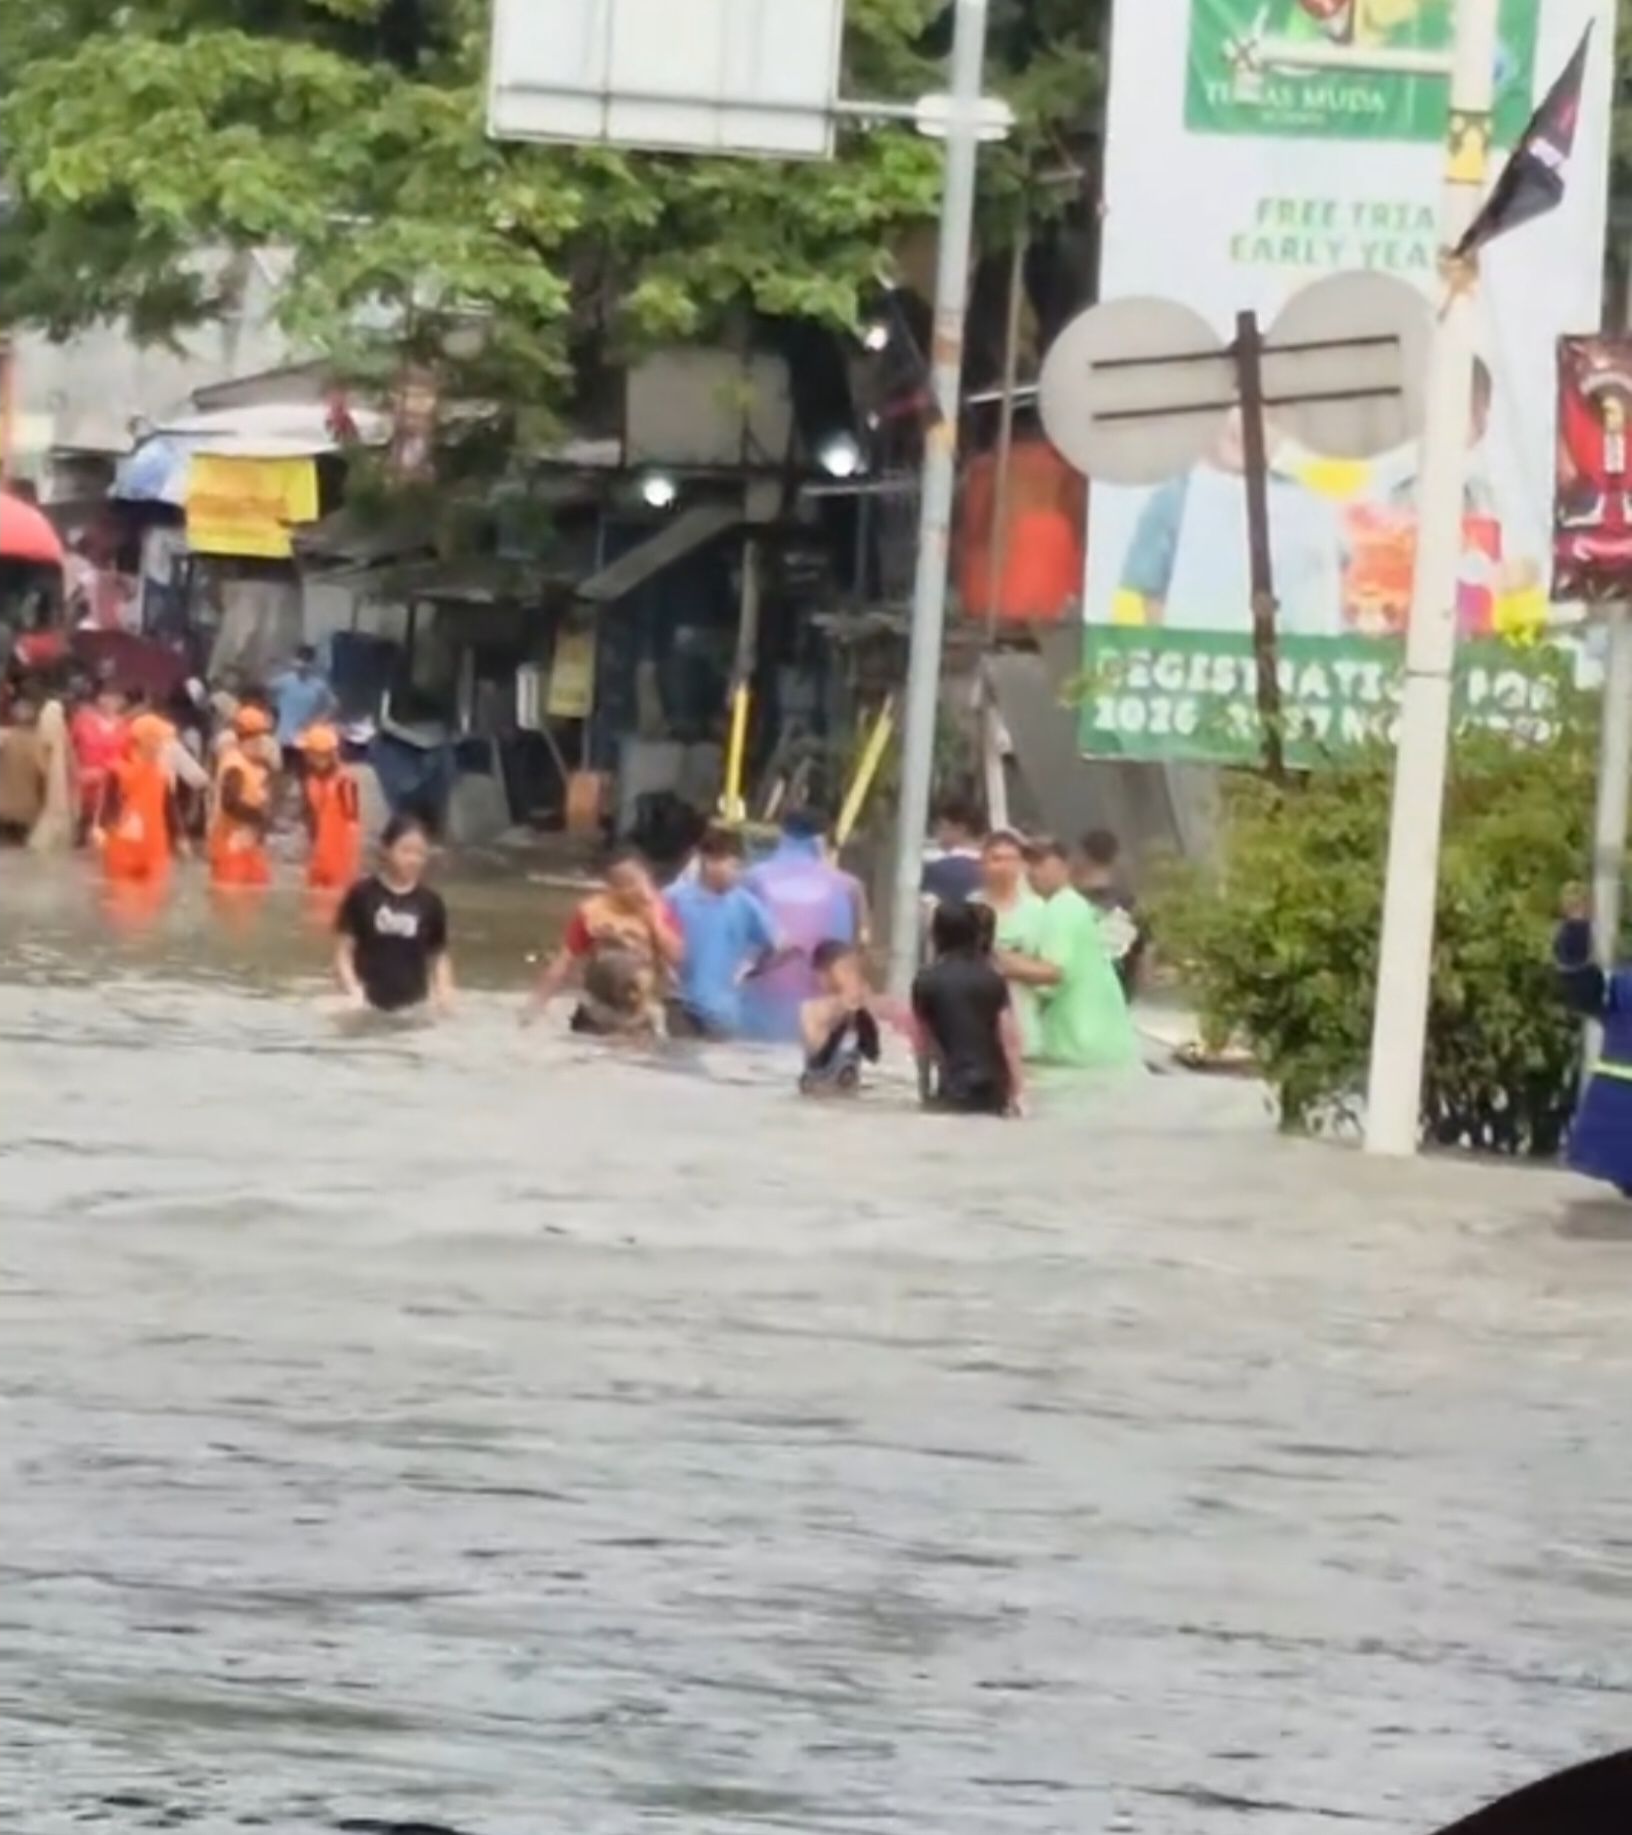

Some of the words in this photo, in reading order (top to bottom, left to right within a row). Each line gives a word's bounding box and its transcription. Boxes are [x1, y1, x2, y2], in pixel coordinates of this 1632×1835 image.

[1302, 86, 1386, 112] MUDA
[1256, 198, 1336, 229] FREE
[1230, 234, 1346, 266] EARLY
